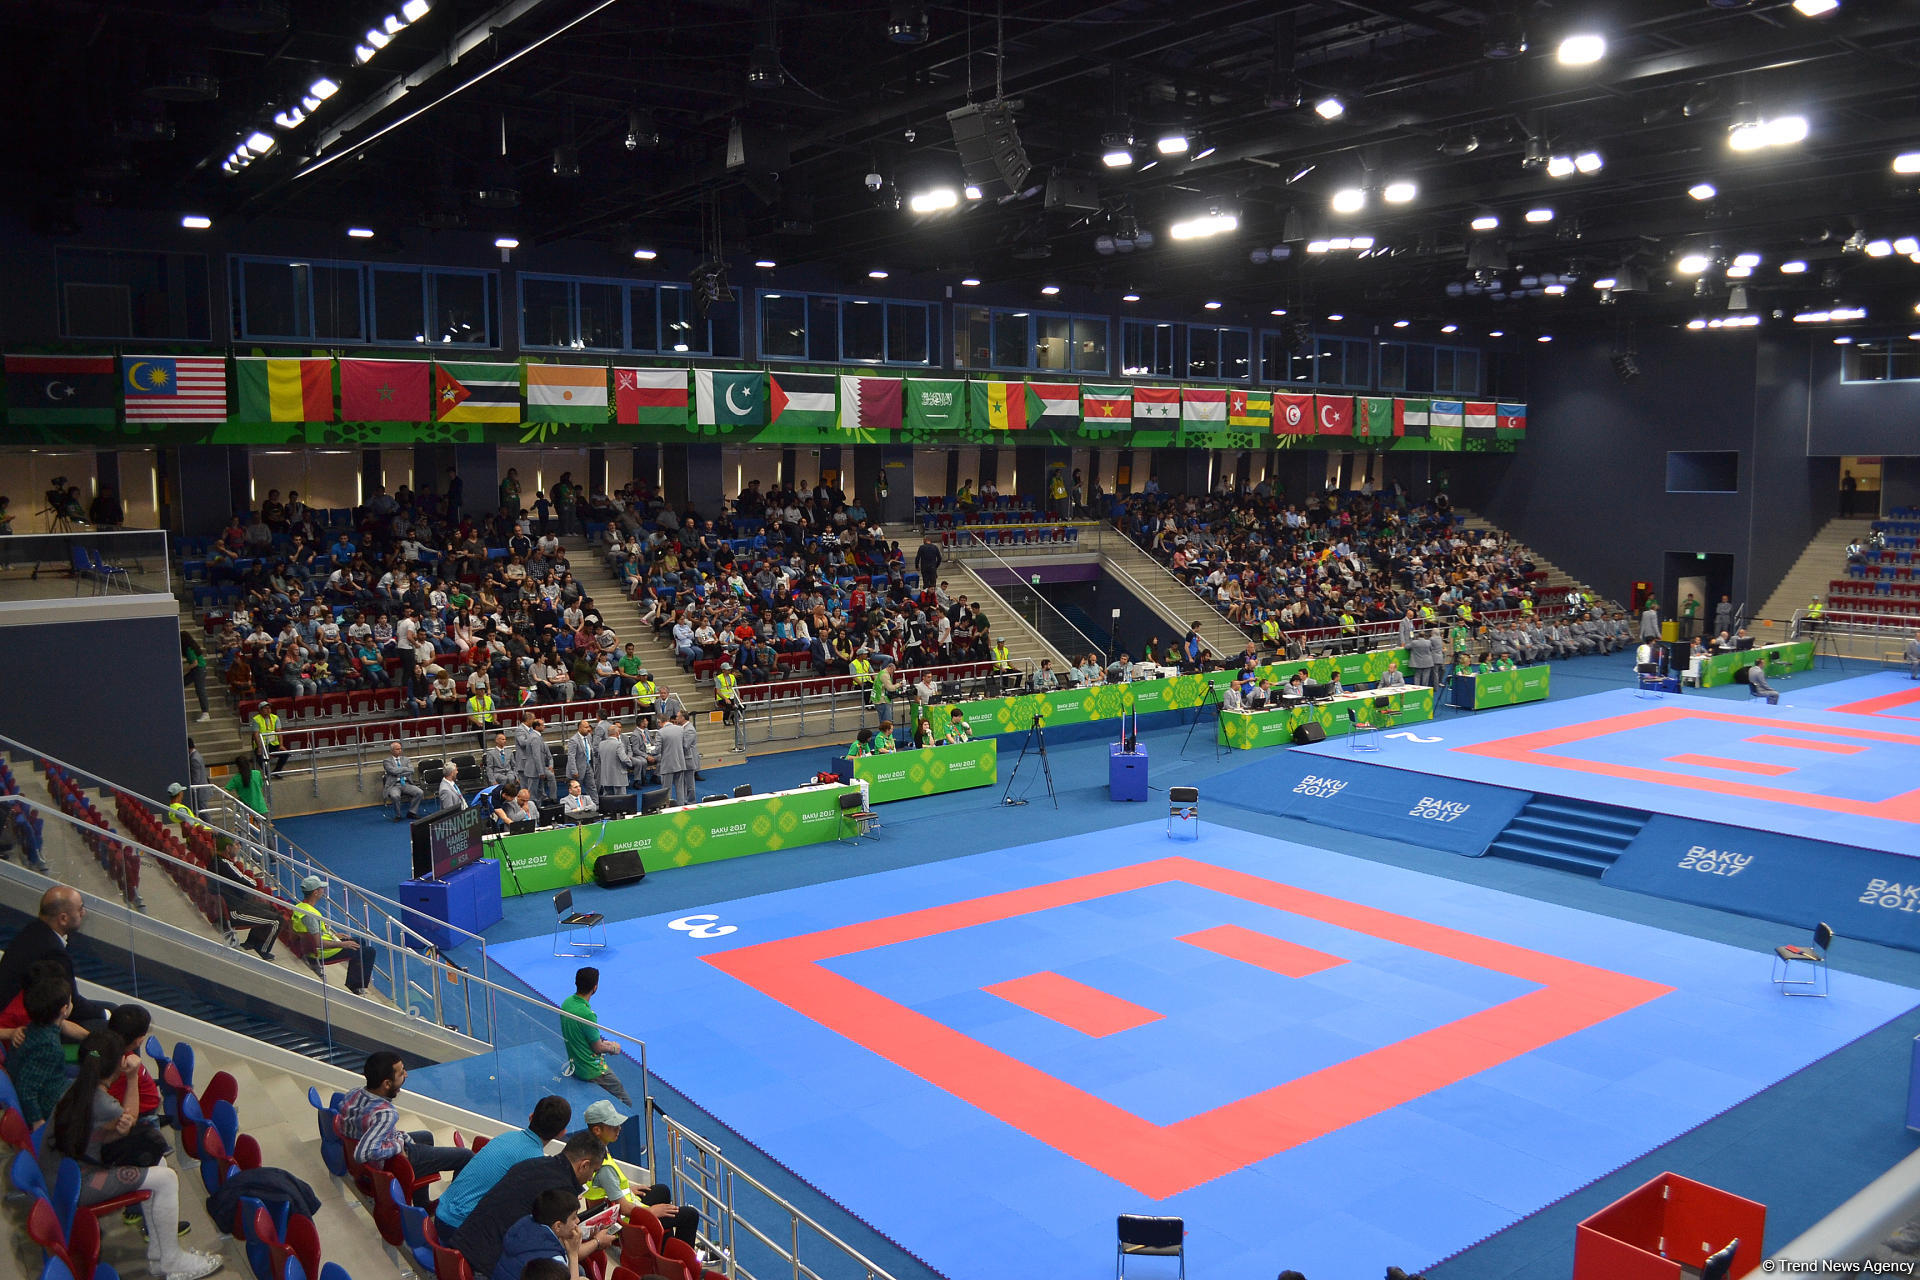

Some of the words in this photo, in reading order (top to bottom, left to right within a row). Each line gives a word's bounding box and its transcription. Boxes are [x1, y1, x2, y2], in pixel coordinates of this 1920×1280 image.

[1293, 783, 1339, 798] 2017
[1301, 775, 1349, 790] BAKU
[1409, 806, 1461, 822] 2017
[1418, 797, 1470, 814] BAKU
[434, 809, 478, 840] WINNER
[446, 830, 469, 848] HAMEDI
[614, 842, 632, 850] BAKU
[633, 839, 652, 847] 2017
[528, 856, 547, 864] 2017
[1686, 846, 1754, 866] BAKU
[1678, 857, 1744, 876] 2017
[1867, 879, 1920, 899] BAK
[1859, 891, 1920, 913] 201
[668, 914, 738, 938] 3
